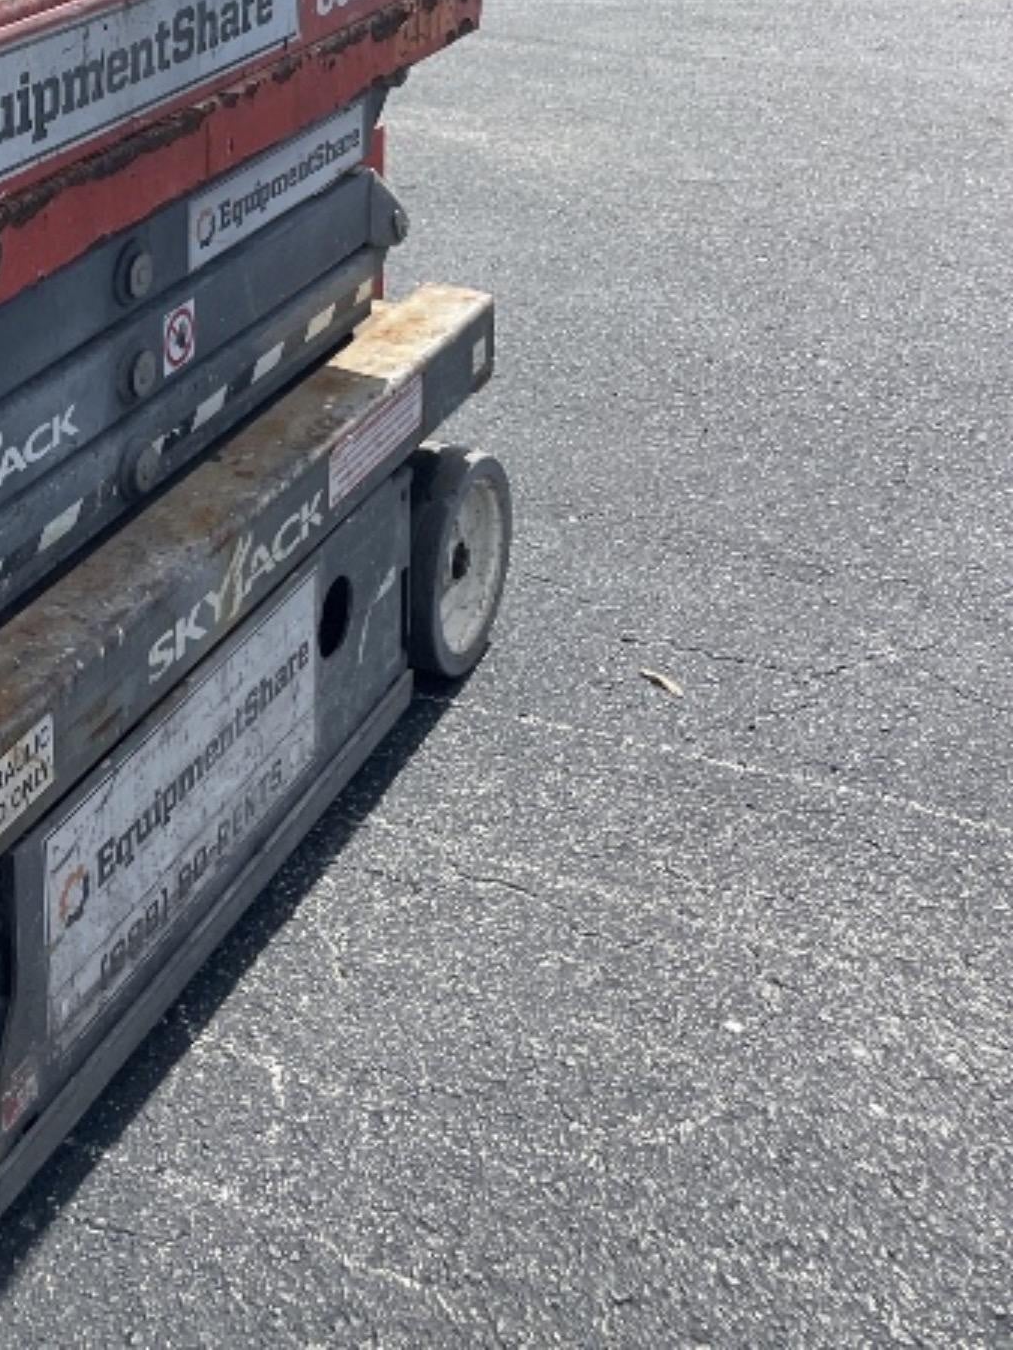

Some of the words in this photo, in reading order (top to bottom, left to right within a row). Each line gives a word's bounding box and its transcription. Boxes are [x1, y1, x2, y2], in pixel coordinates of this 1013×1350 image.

[219, 128, 360, 231] EquipmentShare
[148, 489, 324, 686] SKYJACK
[97, 640, 310, 888] EquipmentShare
